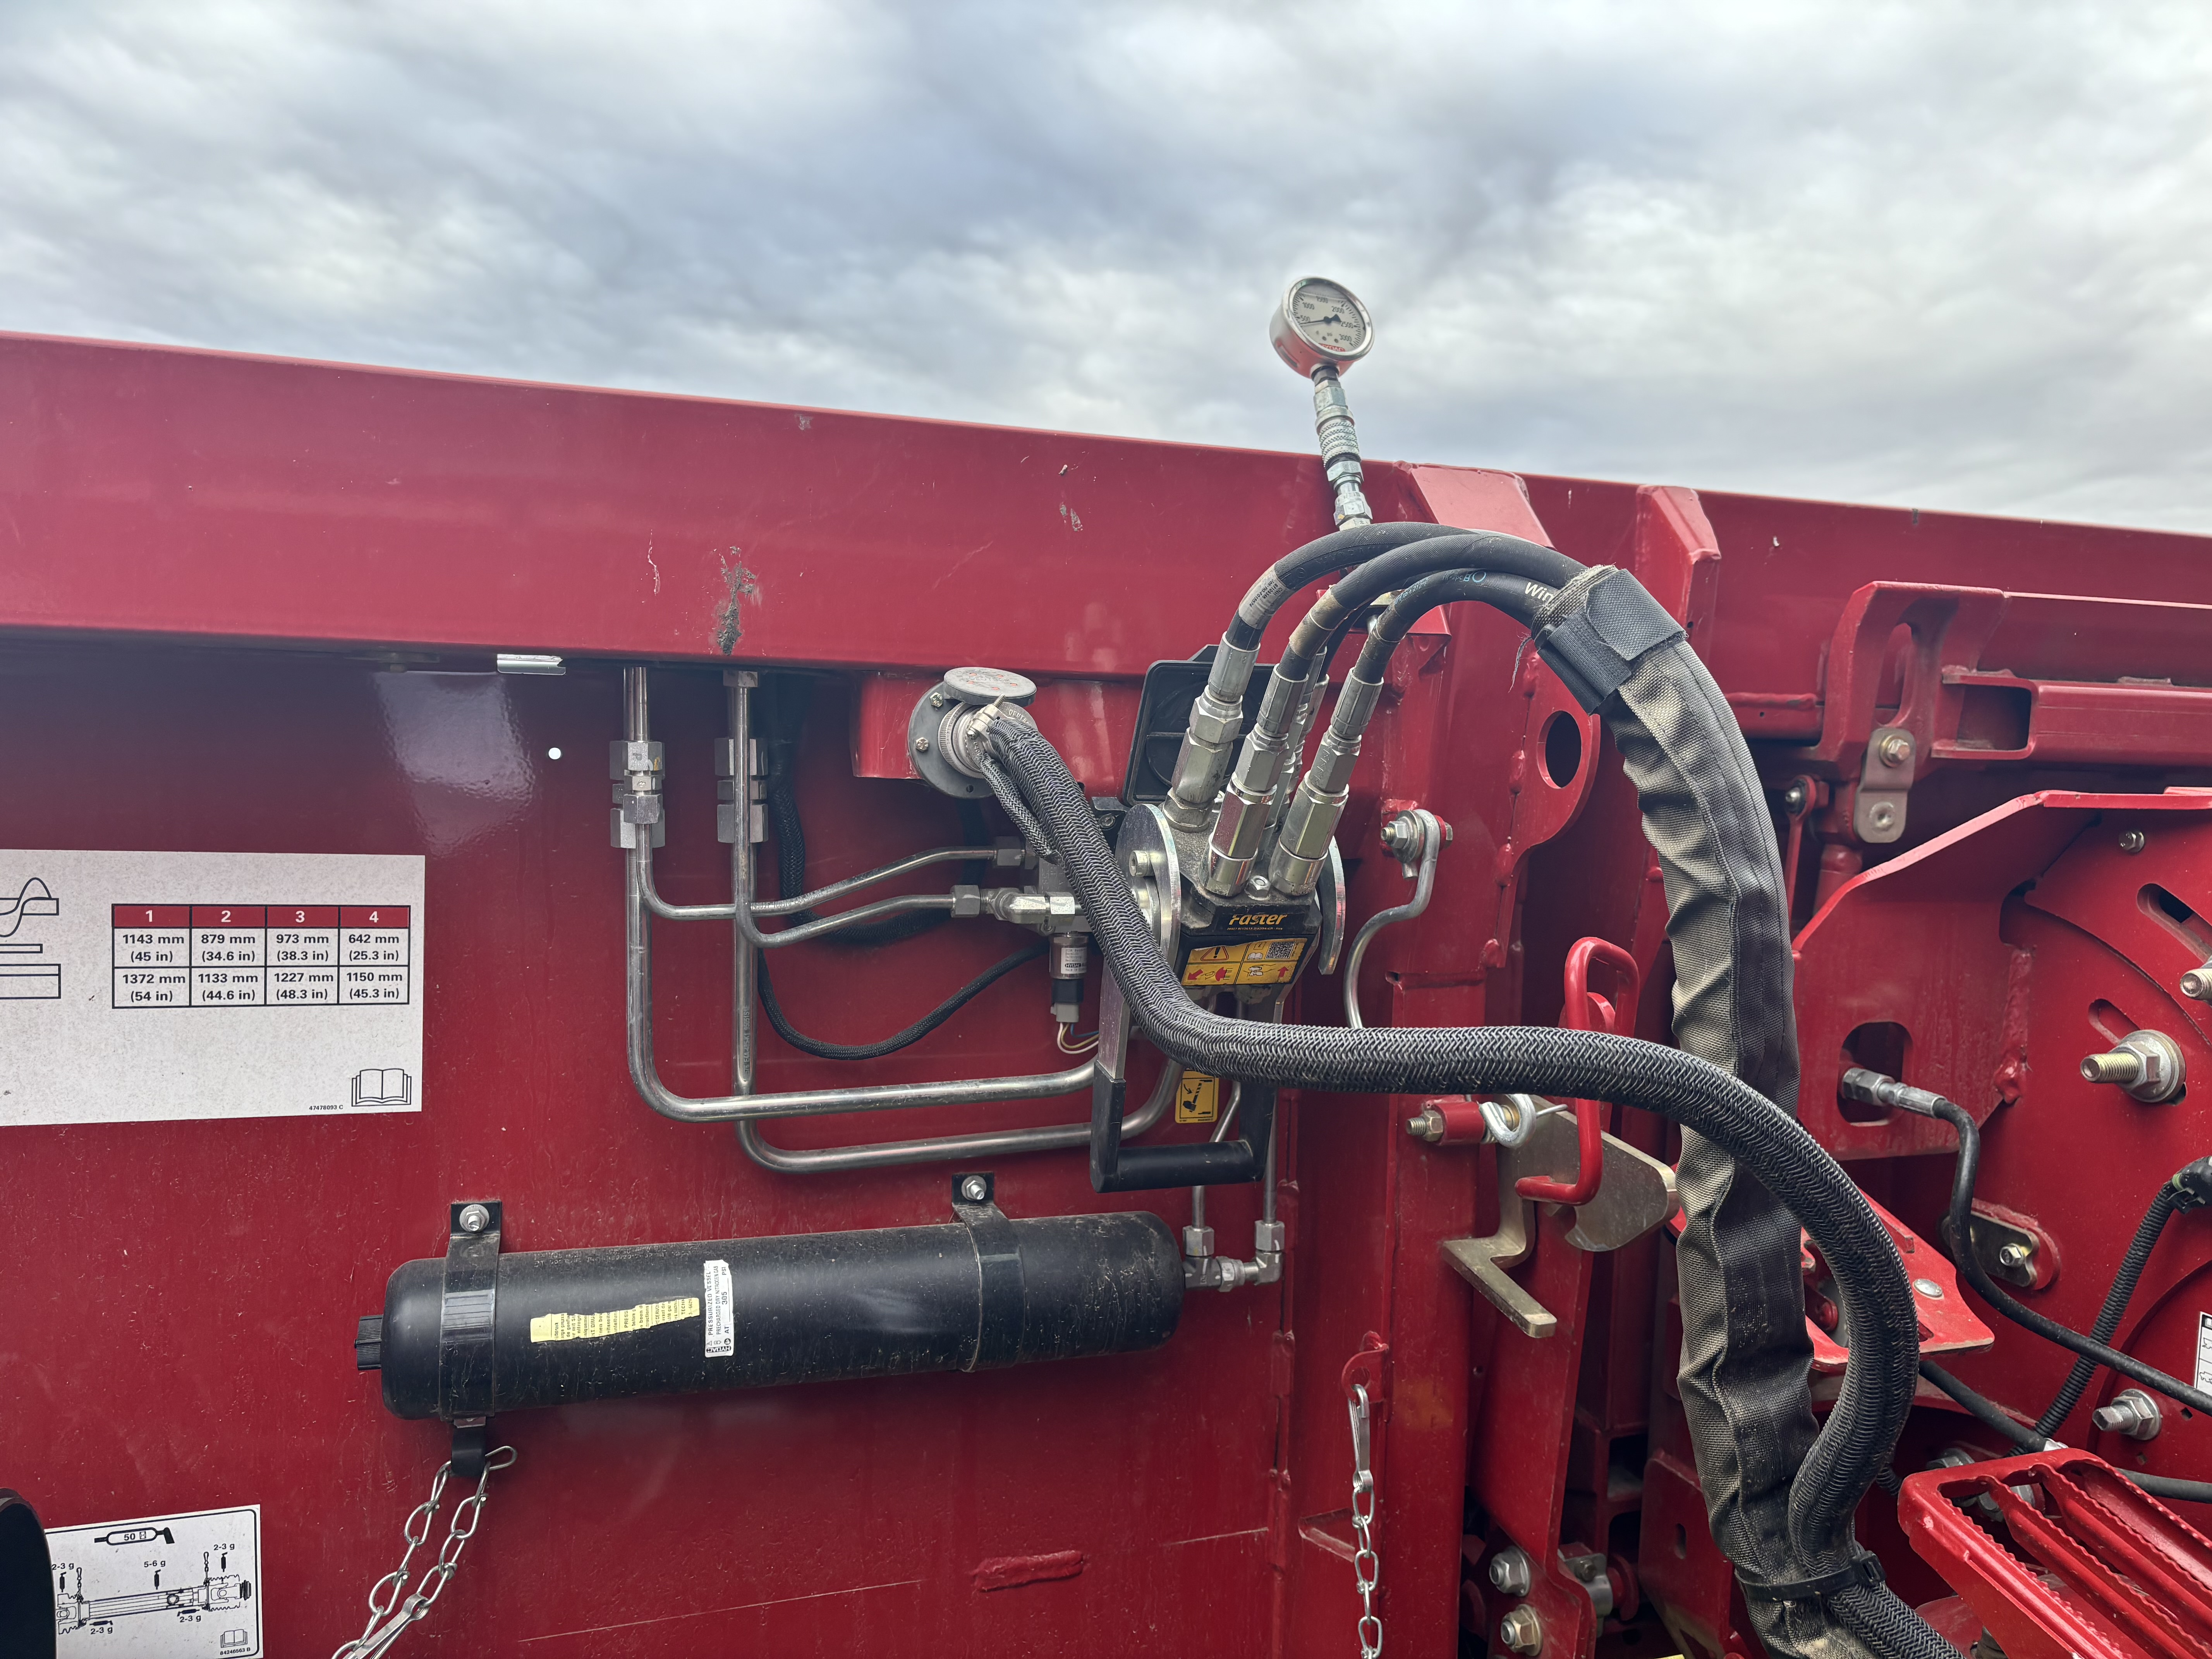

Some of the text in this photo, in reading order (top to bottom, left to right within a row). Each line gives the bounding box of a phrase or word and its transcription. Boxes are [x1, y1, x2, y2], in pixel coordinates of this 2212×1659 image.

[146, 910, 152, 922] 1
[222, 910, 231, 922] 2
[296, 911, 304, 922] 3
[369, 911, 378, 922] 4
[1229, 914, 1288, 925] Faster
[123, 934, 153, 944] 1143
[201, 934, 225, 943] 879
[276, 934, 299, 943] 973
[349, 934, 370, 943] 642
[131, 951, 172, 962] (45 in)
[202, 951, 255, 962] (34.6 in)
[277, 950, 328, 962] (38.3 in)
[349, 950, 398, 961] (25.3 in)
[123, 974, 154, 984] 1372
[198, 974, 227, 983] 1133
[275, 973, 304, 982] 1227
[347, 972, 374, 981] 1150
[131, 991, 172, 1002] (54 in)
[203, 989, 255, 1001] (44.6 in)
[276, 989, 328, 1000] (48.3 in)
[349, 988, 399, 1000] (45.3 in)
